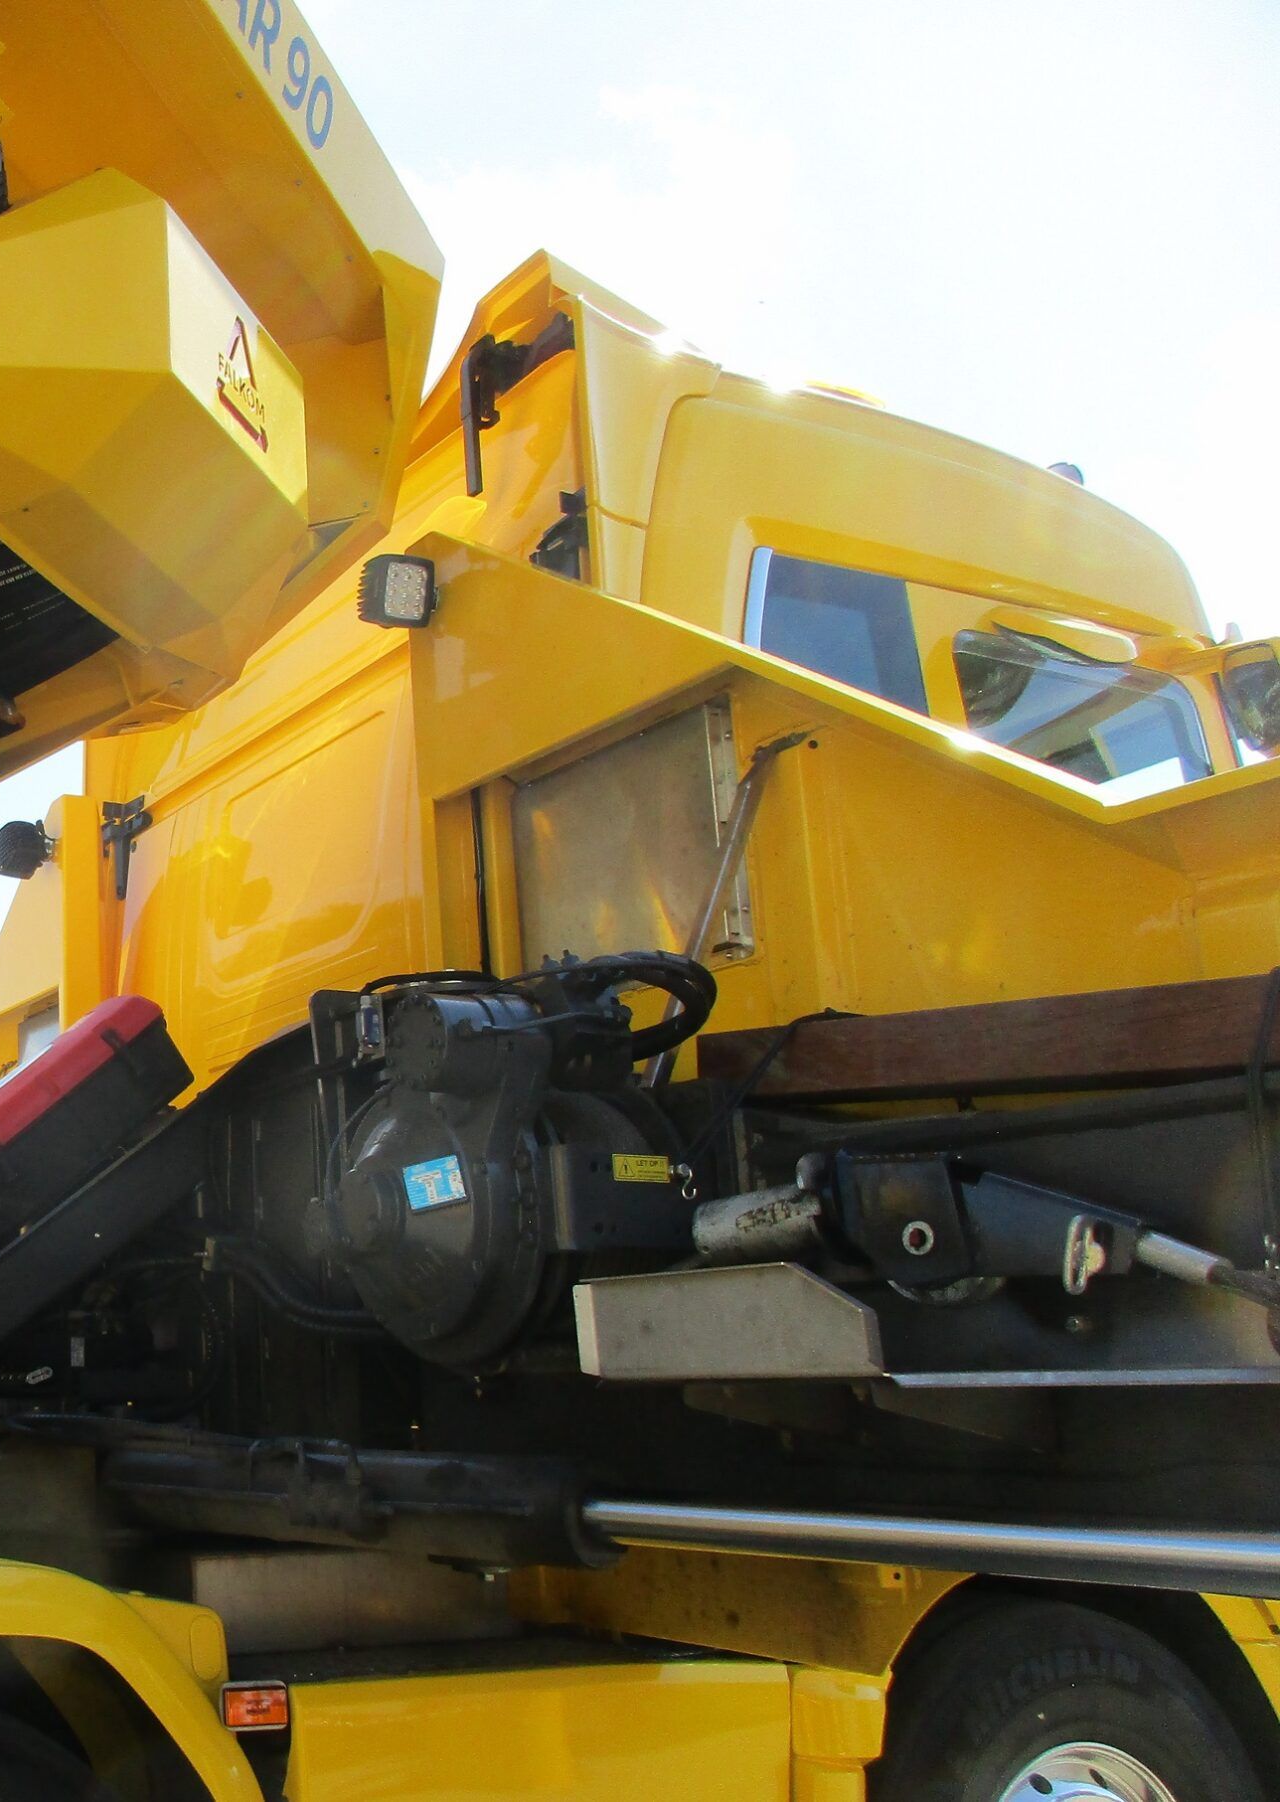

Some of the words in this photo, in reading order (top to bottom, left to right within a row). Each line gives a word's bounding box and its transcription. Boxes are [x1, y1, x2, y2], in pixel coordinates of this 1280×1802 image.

[234, 0, 282, 75] R
[282, 36, 334, 150] 90
[217, 351, 265, 424] FALKOM
